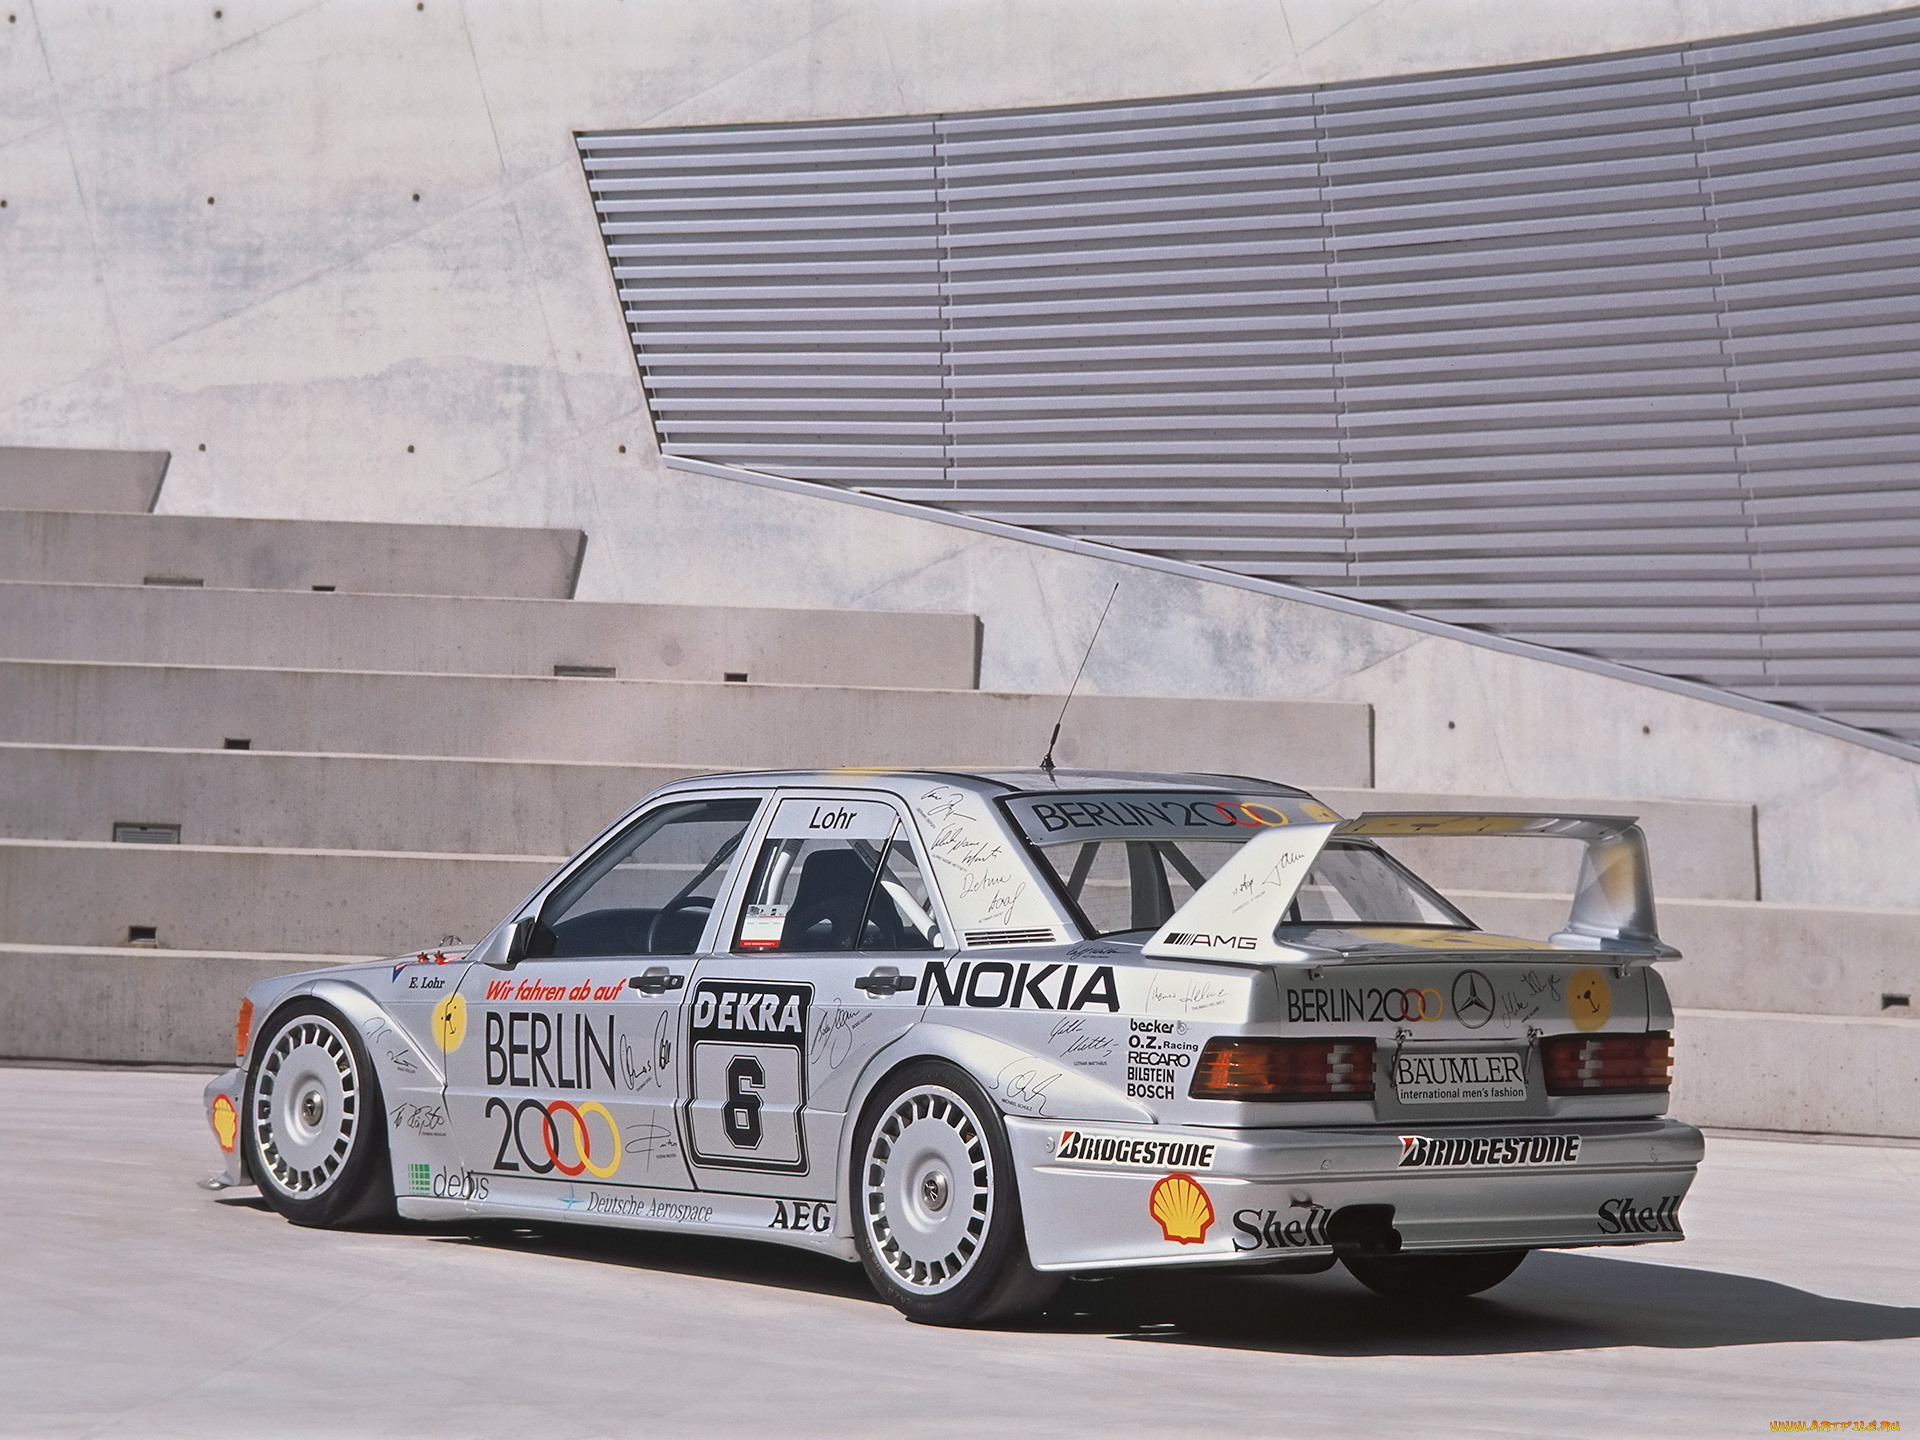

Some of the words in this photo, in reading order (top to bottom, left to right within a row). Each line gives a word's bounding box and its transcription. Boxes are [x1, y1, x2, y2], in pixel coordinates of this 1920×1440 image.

[808, 806, 858, 829] Lohr
[1031, 801, 1177, 833] BERLIN
[1162, 801, 1289, 828] 2000
[1190, 934, 1258, 950] AMG
[408, 976, 419, 989] E.
[420, 976, 446, 989] Lohr
[485, 979, 515, 1001] Wir
[514, 978, 567, 1001] fahren
[568, 979, 593, 1001] ab
[593, 978, 627, 1001] auf
[916, 961, 1121, 1012] NOKIA
[693, 991, 803, 1034] DEKRA
[1287, 988, 1365, 1023] BERLIN
[1367, 988, 1444, 1022] 2000
[1130, 1018, 1175, 1034] becker
[485, 1011, 617, 1091] BERLIN
[1127, 1051, 1191, 1068] RECARO
[1128, 1035, 1162, 1050] O.Z.
[1163, 1040, 1199, 1052] Racing
[1127, 1067, 1175, 1083] BILSTEIN
[1398, 1056, 1523, 1085] BÄUMLER
[721, 1055, 766, 1150] 6
[1127, 1084, 1175, 1100] BOSCH
[1400, 1088, 1460, 1099] international
[1462, 1087, 1489, 1098] men's
[1491, 1087, 1524, 1098] fashion
[484, 1096, 622, 1179] 2000
[1056, 1130, 1215, 1168] BRIDGESTONE
[1399, 1135, 1580, 1167] BRIDGESTONE
[433, 1165, 490, 1200] debis
[586, 1191, 645, 1217] Deutsche
[646, 1198, 713, 1223] Aerospace
[768, 1200, 832, 1231] AEG
[1597, 1195, 1681, 1235] Shell
[1232, 1208, 1333, 1252] Shell
